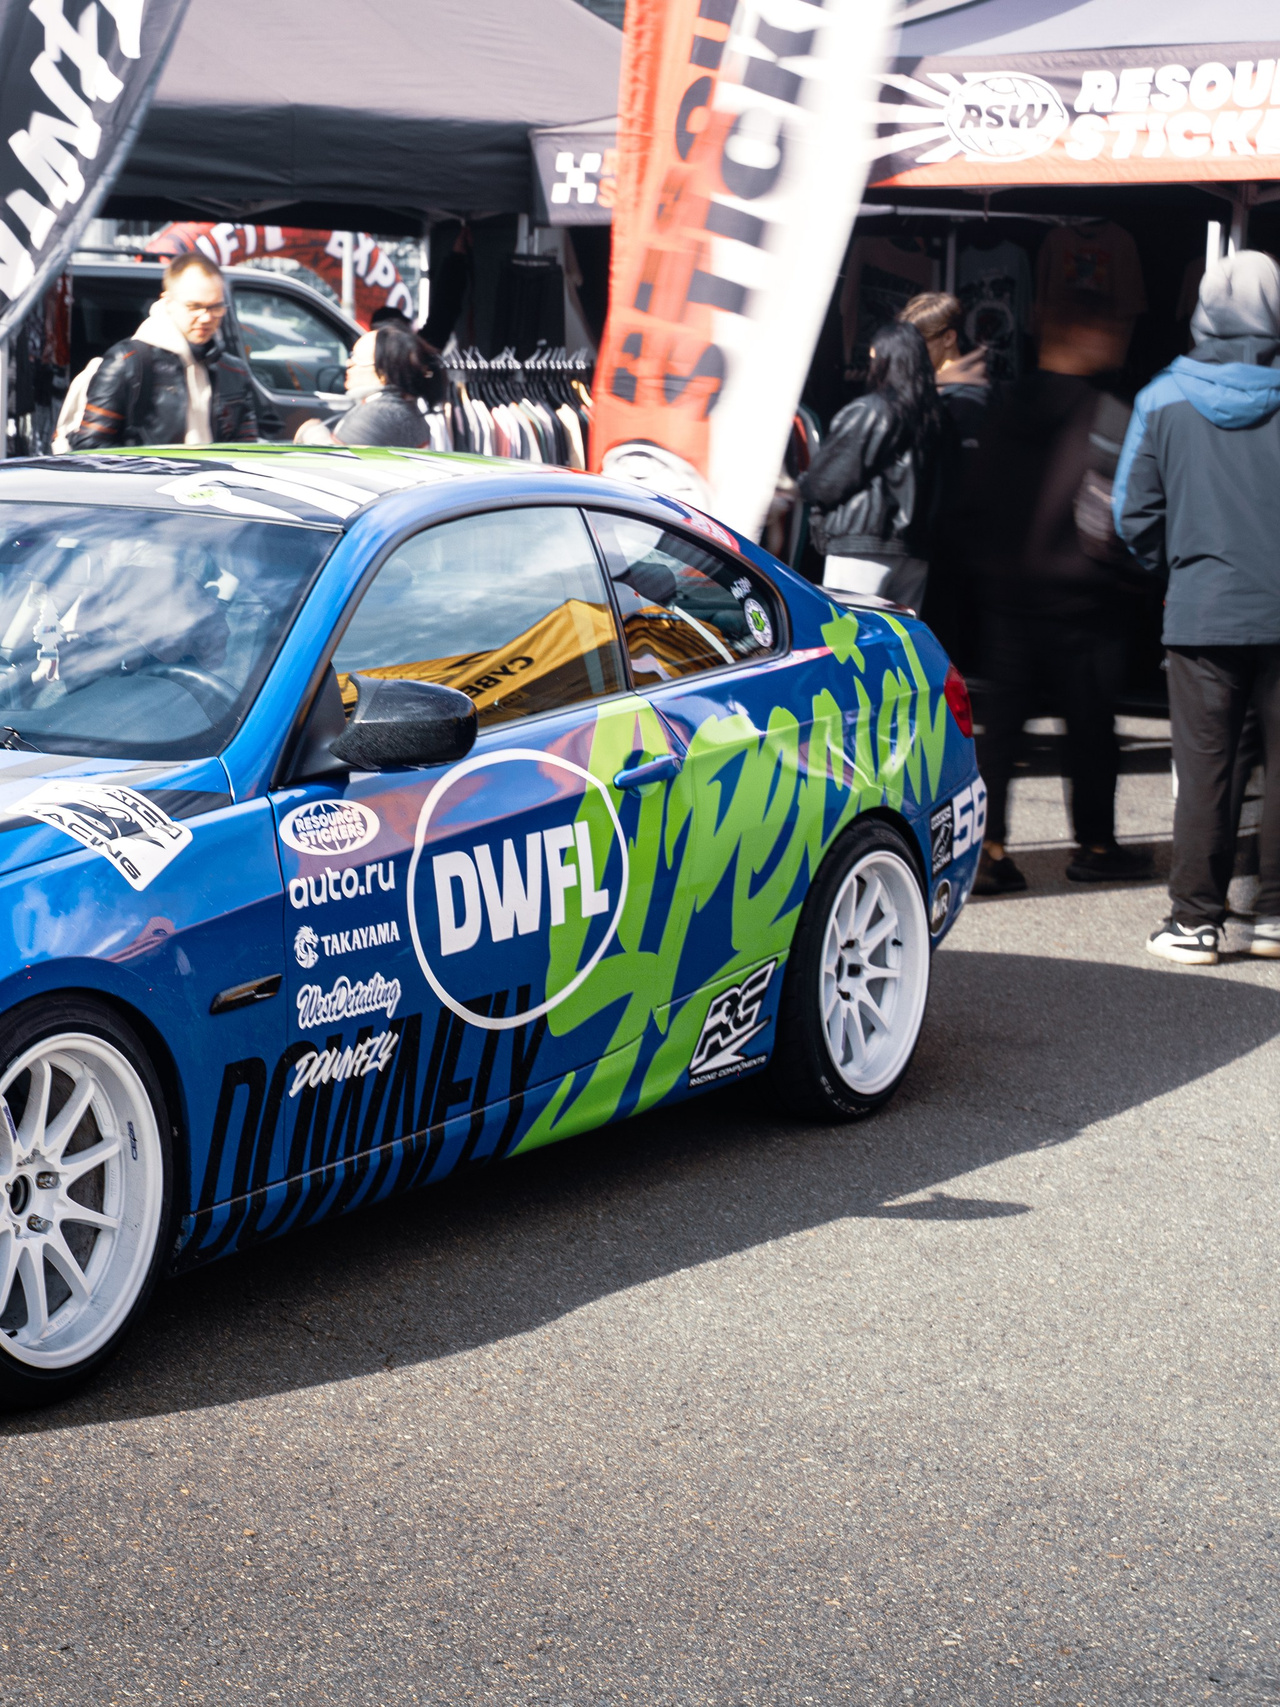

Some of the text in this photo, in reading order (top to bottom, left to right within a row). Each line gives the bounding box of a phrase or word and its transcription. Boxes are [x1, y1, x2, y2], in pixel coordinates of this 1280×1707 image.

[1073, 58, 1280, 114] RESOU
[960, 103, 1050, 129] RSW
[294, 807, 362, 832] RESOURCE
[298, 821, 367, 846] STICKERS
[952, 775, 988, 860] 56
[32, 808, 142, 881] ACING
[288, 860, 396, 910] auto.ru
[433, 820, 610, 957] DWFL
[321, 921, 401, 957] TAKAYAMA
[288, 1030, 400, 1098] DOWNFLY
